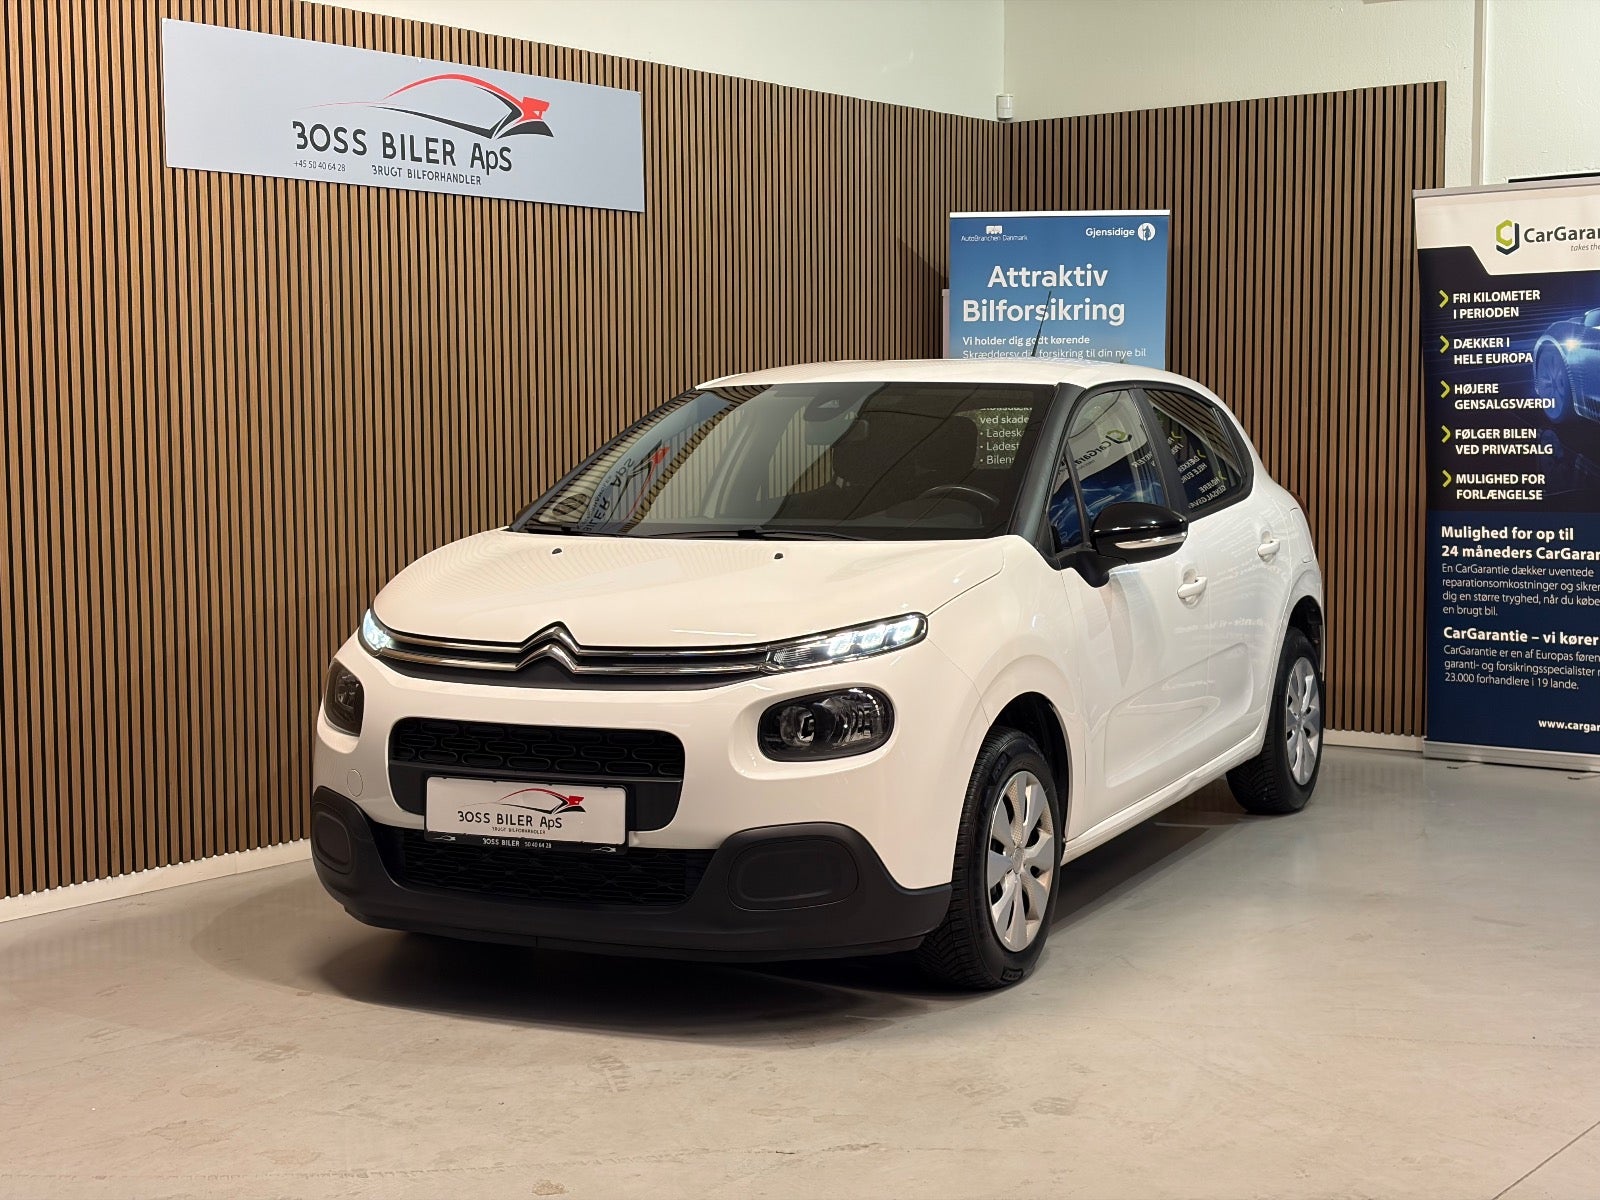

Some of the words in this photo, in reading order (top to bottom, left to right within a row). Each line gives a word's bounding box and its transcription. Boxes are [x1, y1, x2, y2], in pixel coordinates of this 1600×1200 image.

[382, 131, 457, 167] BILER
[470, 142, 513, 176] ApS
[294, 160, 306, 168] +45
[308, 160, 316, 169] 50
[328, 162, 336, 170] 64
[338, 164, 346, 172] 28
[407, 168, 482, 186] BILFORHANDLER
[1085, 227, 1135, 239] Gjensidige
[1524, 226, 1600, 243] CarGara
[1570, 244, 1590, 252] takes
[987, 263, 1109, 288] Attraktiv
[1453, 292, 1471, 304] FRI
[1473, 290, 1540, 302] KILOMETER
[962, 298, 1126, 326] Bilforsikring
[1453, 309, 1457, 320] I
[1460, 307, 1520, 319] PERIODEN
[962, 336, 972, 345] Vi
[974, 336, 1006, 345] holder
[1008, 336, 1024, 346] dig
[1025, 336, 1048, 346] godt
[1050, 335, 1090, 344] kørende
[1454, 338, 1504, 349] DÆKKER
[1506, 337, 1510, 347] I
[962, 349, 1020, 358] Skræddersy
[1039, 349, 1084, 359] forsikring
[1086, 349, 1096, 357] til
[1098, 349, 1112, 357] din
[1115, 350, 1133, 359] nye
[1135, 348, 1146, 356] bil
[1454, 354, 1483, 364] HELE
[1486, 353, 1534, 364] EUROPA
[1454, 383, 1499, 394] HØJERE
[1454, 398, 1556, 410] GENSALGSVÆRDI
[980, 415, 999, 424] ved
[986, 428, 1024, 438] Ladesk
[1455, 428, 1500, 440] FØLGER
[1503, 428, 1537, 439] BILEN
[1455, 444, 1479, 455] VED
[1482, 444, 1554, 455] PRIVATSALG
[1456, 474, 1518, 484] MULIGHED
[1522, 474, 1546, 484] FOR
[1456, 490, 1543, 500] FORLÆNGELSE
[1441, 526, 1508, 541] Mulighed
[1512, 526, 1533, 539] for
[1536, 529, 1555, 542] op
[1559, 528, 1574, 541] til
[1441, 545, 1459, 557] 24
[1462, 545, 1533, 558] måneders
[1442, 563, 1453, 573] En
[1455, 564, 1510, 574] CarGarantie
[1511, 565, 1546, 576] dækker
[1548, 566, 1594, 577] uventede
[1442, 578, 1558, 592] reparationsomkostninger
[1560, 582, 1574, 593] og
[1443, 591, 1457, 602] dig
[1474, 593, 1500, 602] større
[1502, 593, 1541, 605] tryghed,
[1544, 594, 1558, 604] når
[1561, 595, 1574, 605] du
[1576, 595, 1600, 606] købe
[1457, 605, 1482, 617] brugt
[1485, 606, 1498, 616] bil.
[1444, 626, 1528, 642] CarGarantie
[1543, 631, 1556, 644] vi
[1560, 631, 1599, 646] kører
[1444, 645, 1497, 656] CarGarantie
[1499, 649, 1508, 657] er
[1524, 649, 1534, 659] af
[1536, 649, 1574, 662] Europas
[1444, 660, 1479, 670] garanti-
[1481, 663, 1494, 672] og
[1496, 661, 1595, 676] forsikringsspecialister
[1445, 672, 1475, 682] 23.000
[1476, 673, 1530, 687] forhandlere
[1537, 678, 1548, 687] 19
[1550, 678, 1580, 690] lande.
[496, 814, 533, 827] BILER
[540, 817, 562, 830] ApS
